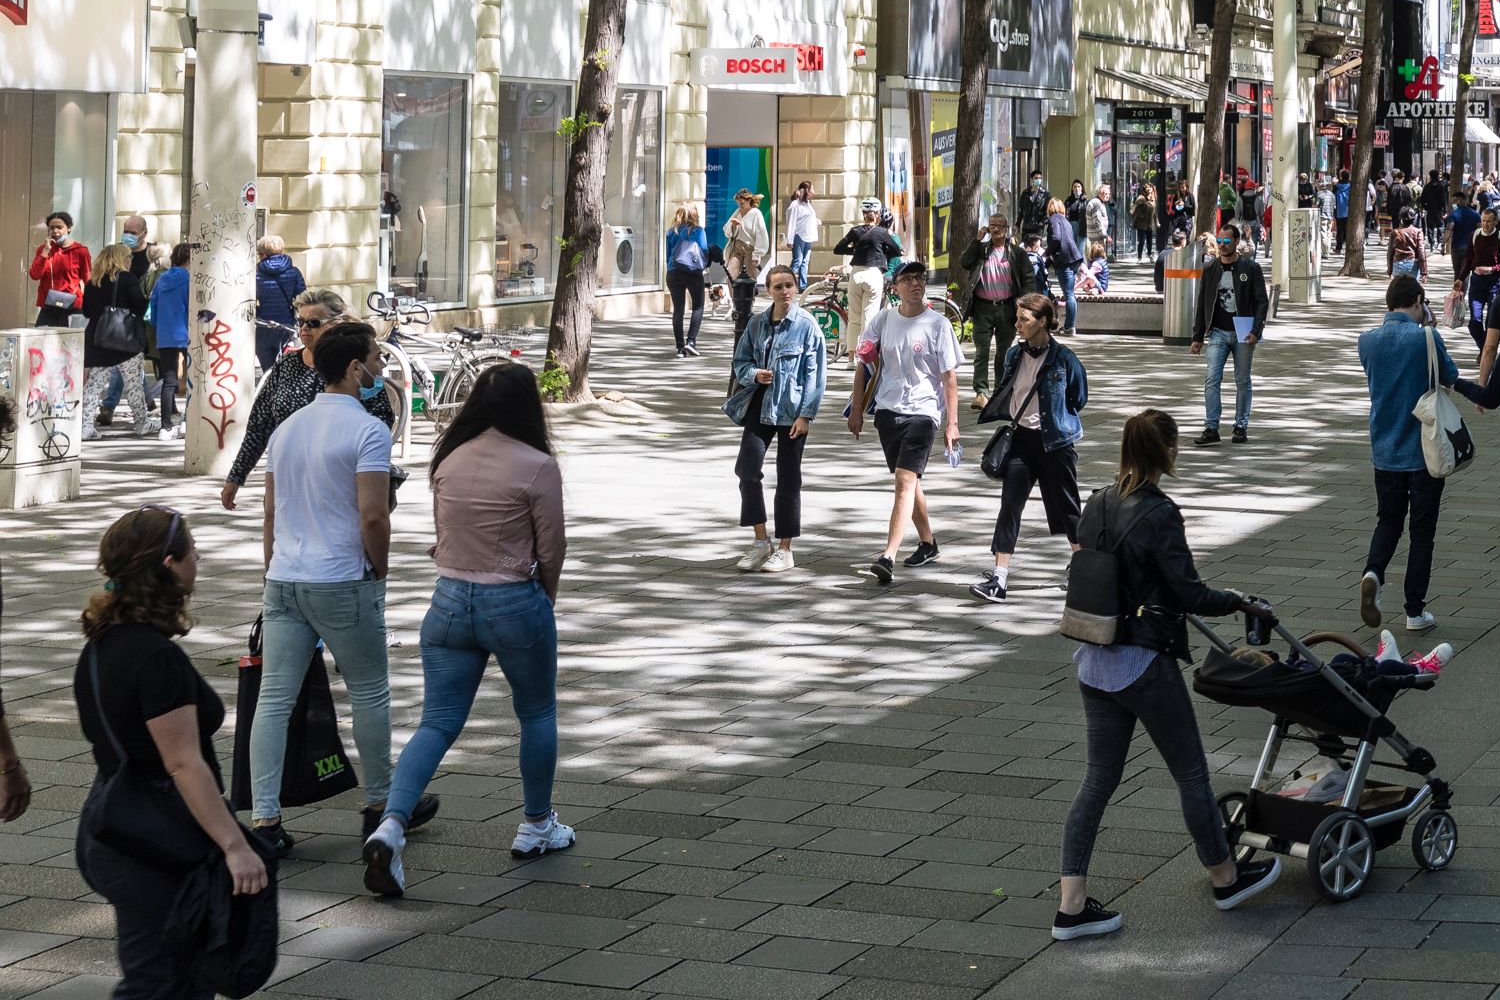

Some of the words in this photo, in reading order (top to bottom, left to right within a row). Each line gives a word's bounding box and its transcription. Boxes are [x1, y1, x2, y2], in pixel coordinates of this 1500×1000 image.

[726, 58, 786, 74] BOSCH
[1132, 109, 1155, 117] zero
[933, 133, 956, 151] AUSVER
[706, 163, 723, 172] ben
[938, 206, 951, 252] 7
[314, 754, 344, 777] XXL
